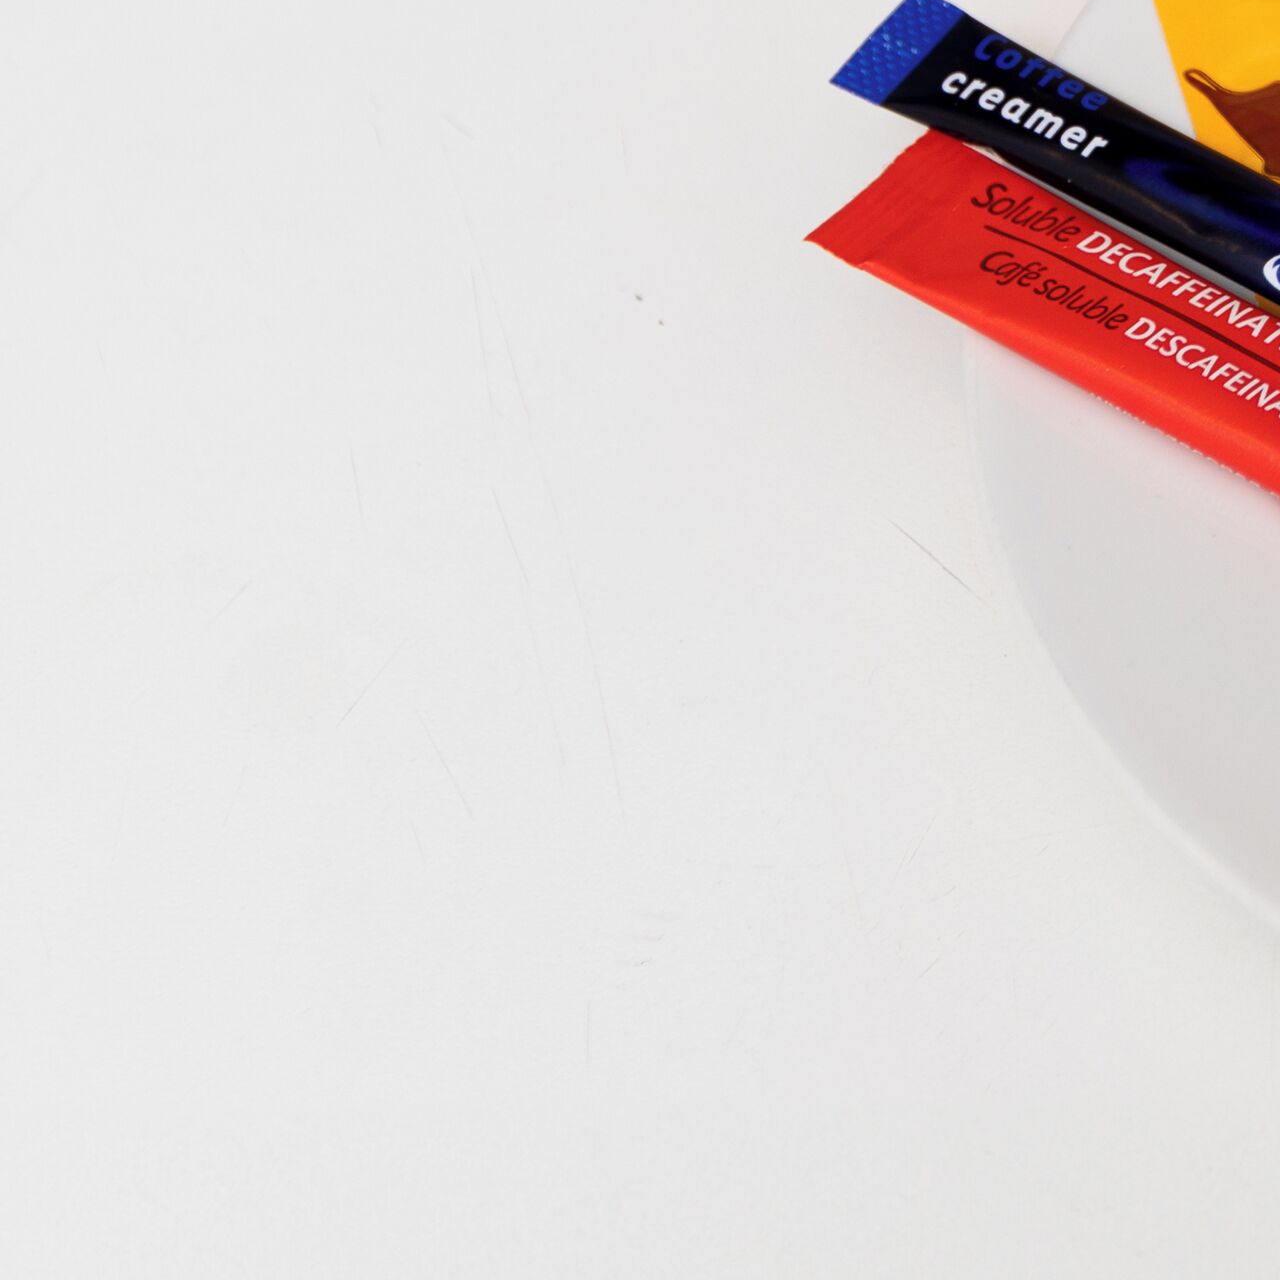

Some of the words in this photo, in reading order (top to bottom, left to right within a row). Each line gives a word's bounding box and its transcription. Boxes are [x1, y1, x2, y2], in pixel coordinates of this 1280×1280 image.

[974, 34, 1109, 112] Coffee
[940, 70, 1109, 159] creamer
[970, 182, 1082, 243] Soluble
[980, 250, 1043, 290] Café
[1033, 278, 1128, 332] soluble
